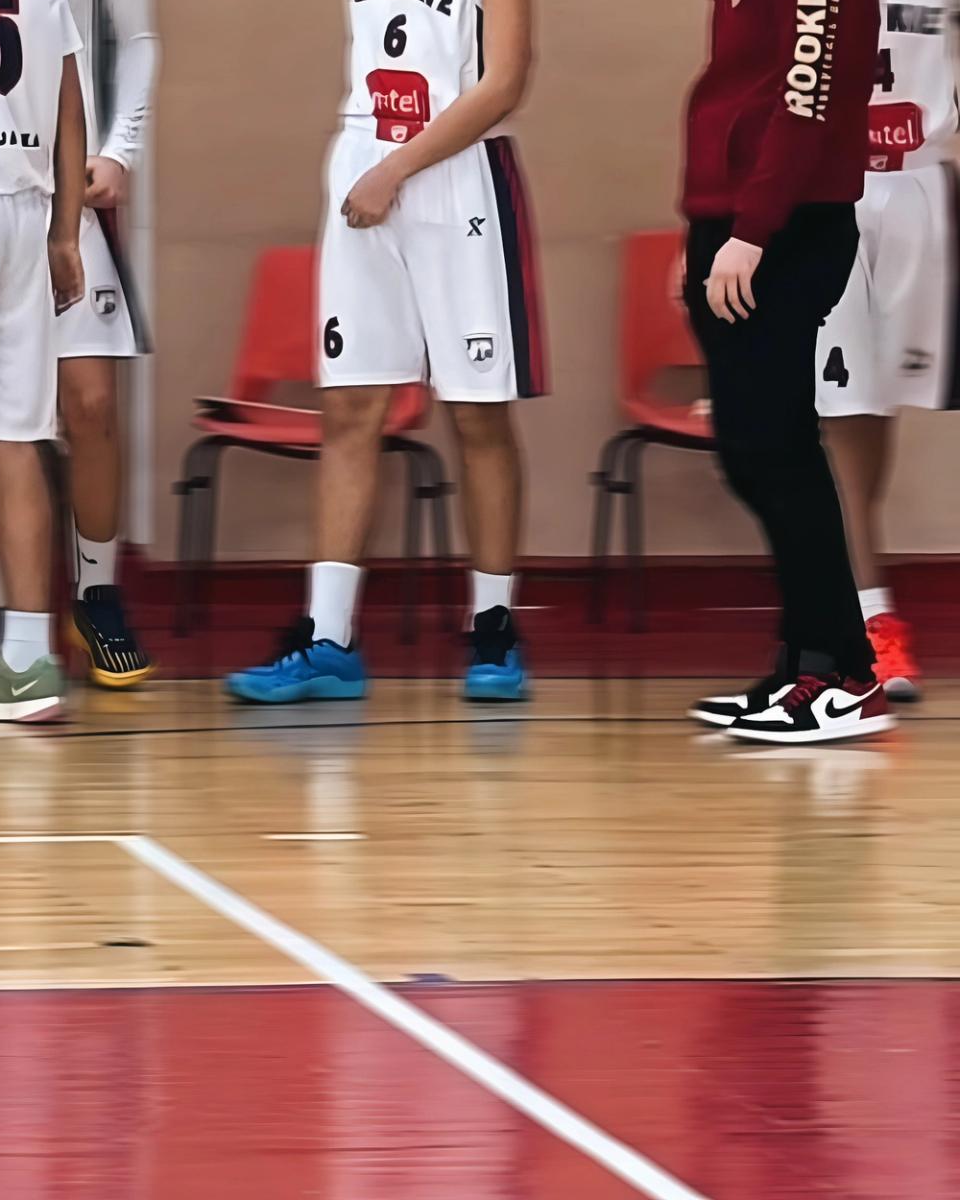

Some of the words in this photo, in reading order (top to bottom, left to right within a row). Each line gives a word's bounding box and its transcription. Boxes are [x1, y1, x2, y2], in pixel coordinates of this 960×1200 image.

[383, 13, 407, 58] 6
[324, 316, 344, 359] 6
[822, 346, 849, 387] 4
